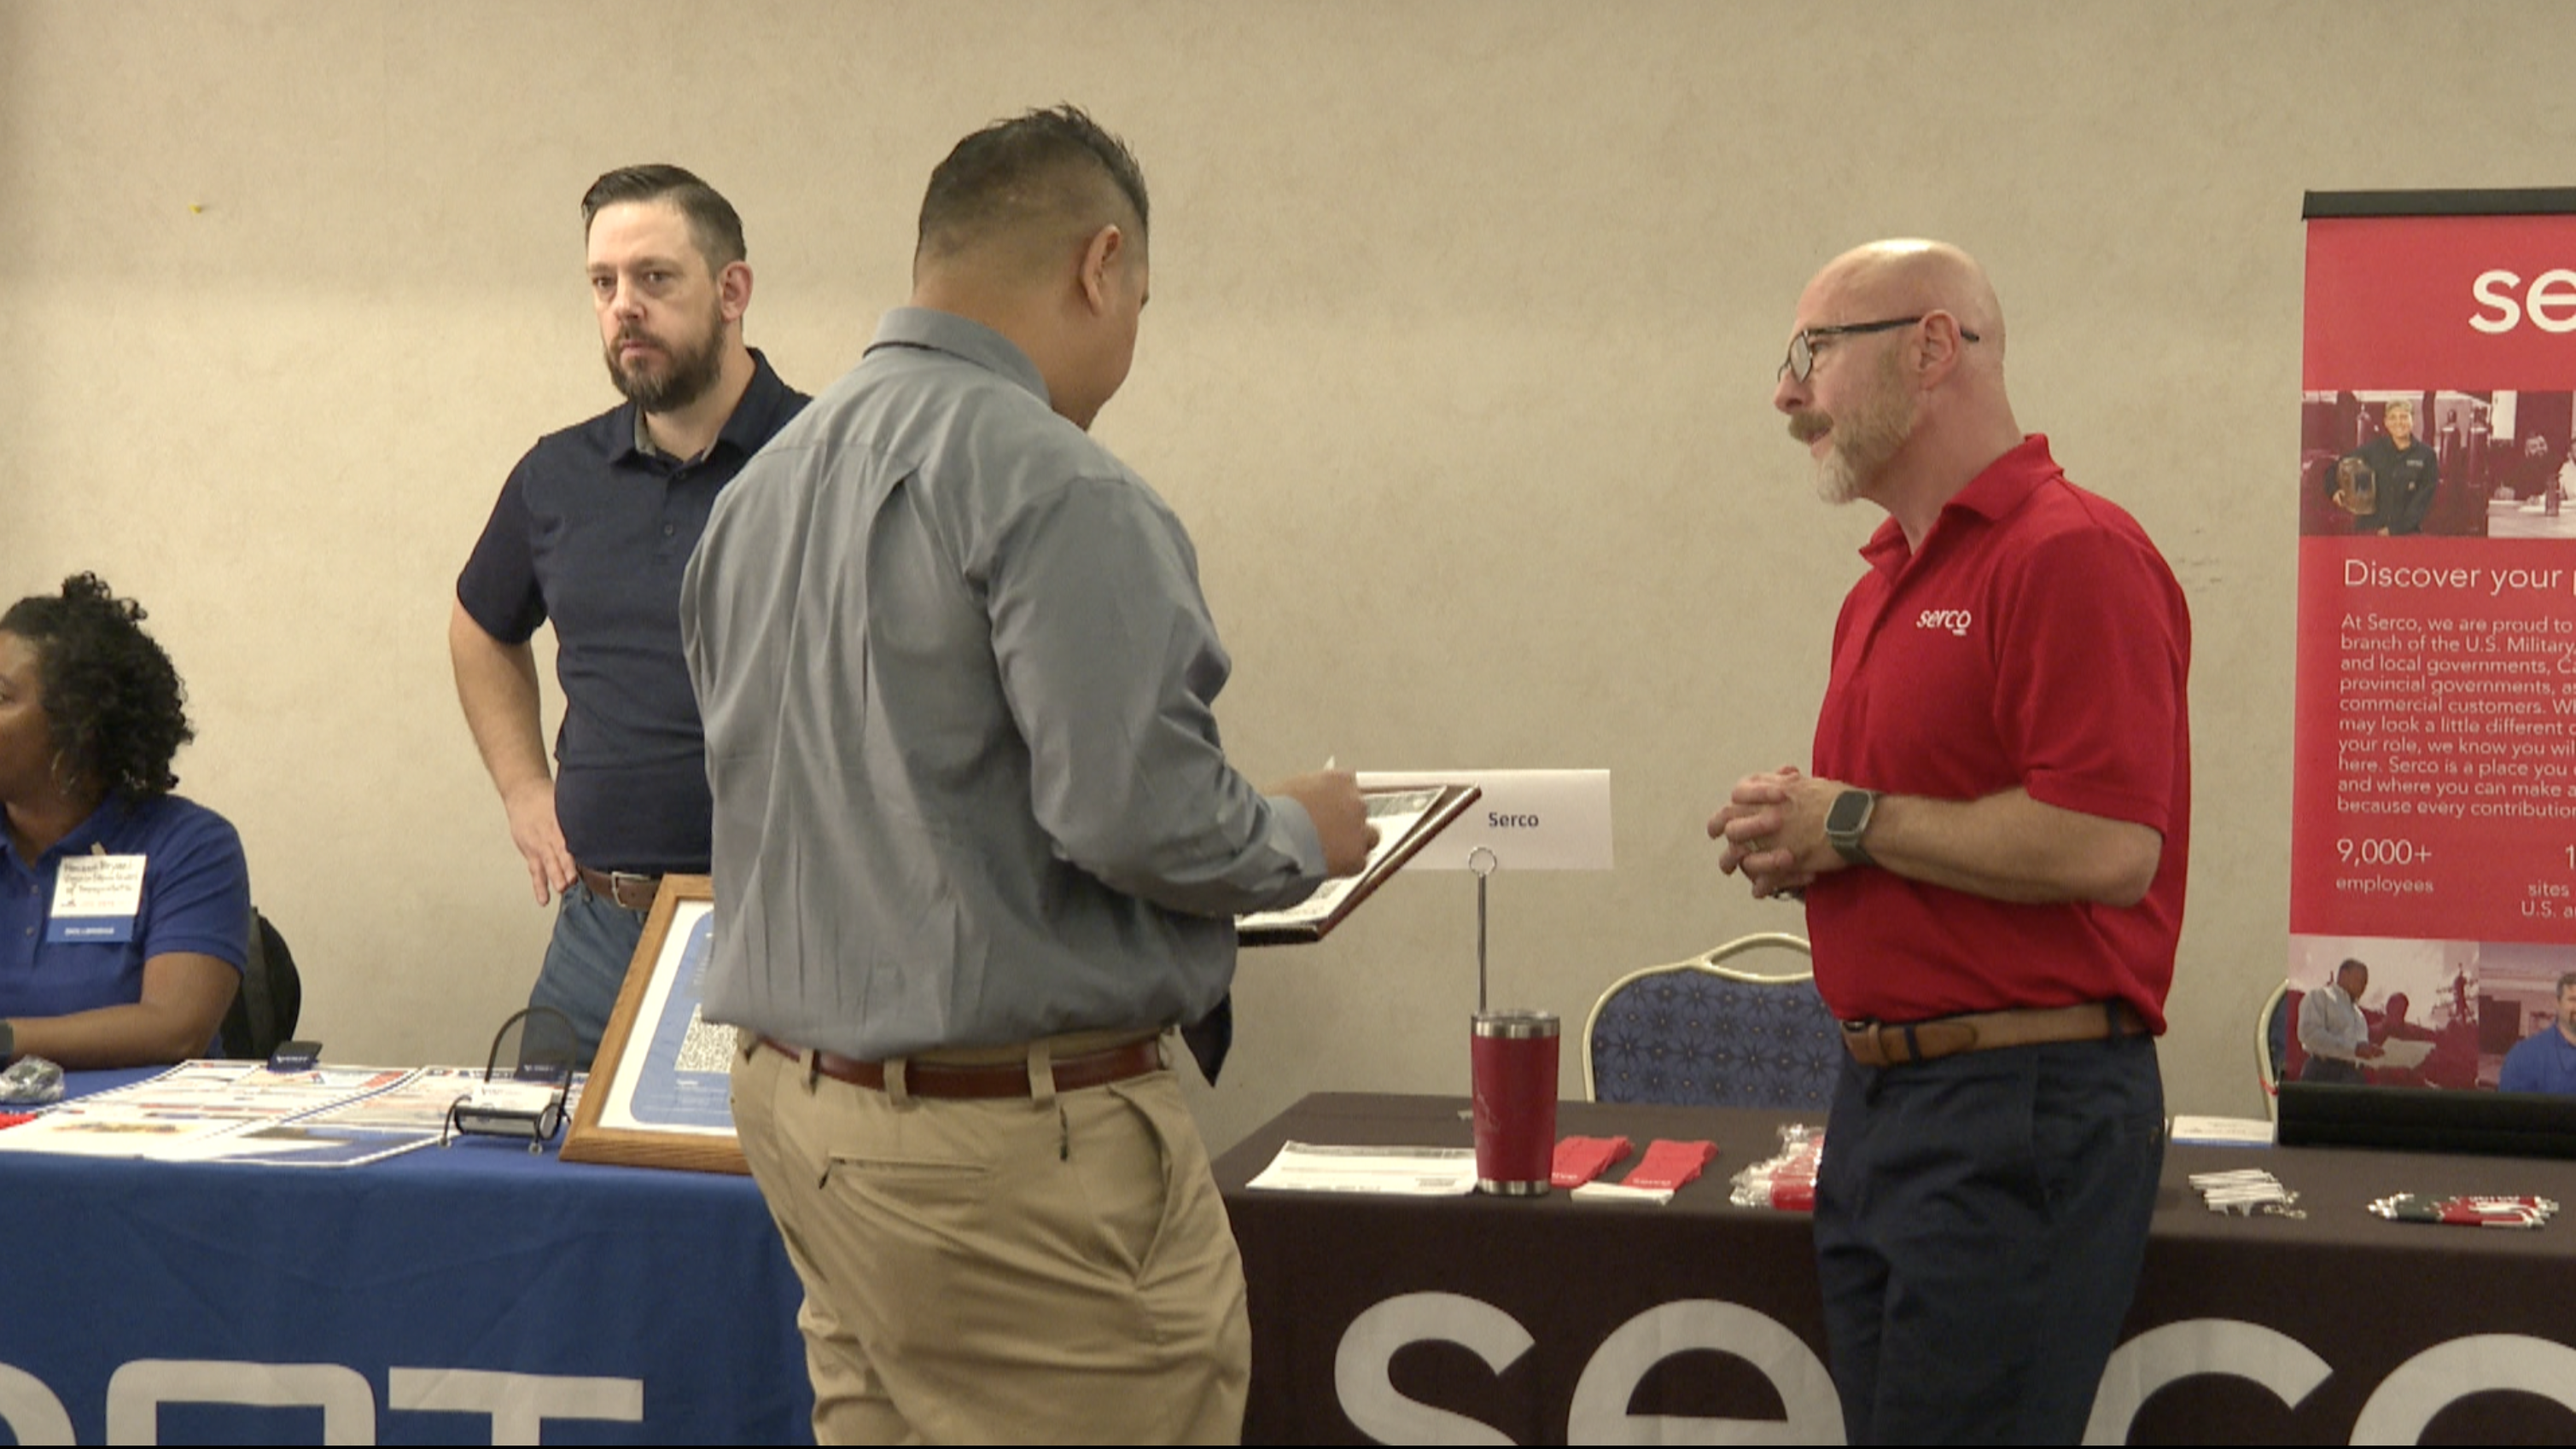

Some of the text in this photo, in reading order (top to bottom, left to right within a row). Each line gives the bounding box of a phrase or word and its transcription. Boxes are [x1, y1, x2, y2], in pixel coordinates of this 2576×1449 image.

[2345, 559, 2480, 588] Discover
[2491, 569, 2562, 596] your
[1916, 609, 1972, 630] serco
[2341, 614, 2573, 634] At Serco, we are proud to
[2341, 635, 2402, 650] branch
[2408, 636, 2426, 651] of
[2432, 637, 2460, 652] the
[2466, 637, 2501, 652] U.S.
[2341, 655, 2375, 671] and
[2381, 655, 2421, 671] local
[2427, 659, 2551, 677] governments,
[2340, 676, 2426, 693] provincial
[2432, 679, 2555, 696] governments,
[2340, 696, 2443, 713] commercial
[2448, 700, 2546, 715] customers.
[2340, 719, 2376, 736] may
[2381, 716, 2420, 732] look
[2425, 720, 2436, 733] a
[2441, 718, 2480, 734] little
[2486, 719, 2563, 736] different
[2339, 740, 2377, 755] your
[2383, 737, 2422, 754] role,
[2427, 742, 2453, 754] we
[2459, 737, 2507, 754] know
[2512, 742, 2544, 759] you
[2339, 756, 2381, 772] here.
[2389, 756, 2439, 773] Serco
[2445, 759, 2458, 774] is
[2464, 763, 2474, 775] a
[2479, 759, 2528, 778] place
[2534, 764, 2567, 781] you
[2338, 777, 2371, 793] and
[2376, 777, 2431, 794] where
[2436, 781, 2469, 798] you
[2474, 783, 2506, 795] can
[2512, 780, 2561, 797] make
[2337, 795, 2411, 813] because
[2417, 801, 2465, 818] every
[1489, 812, 1539, 827] Serco
[2336, 839, 2433, 867] 9,000+
[2336, 876, 2433, 896] employees
[2528, 880, 2569, 898] sites
[2521, 899, 2556, 918] U.S.
